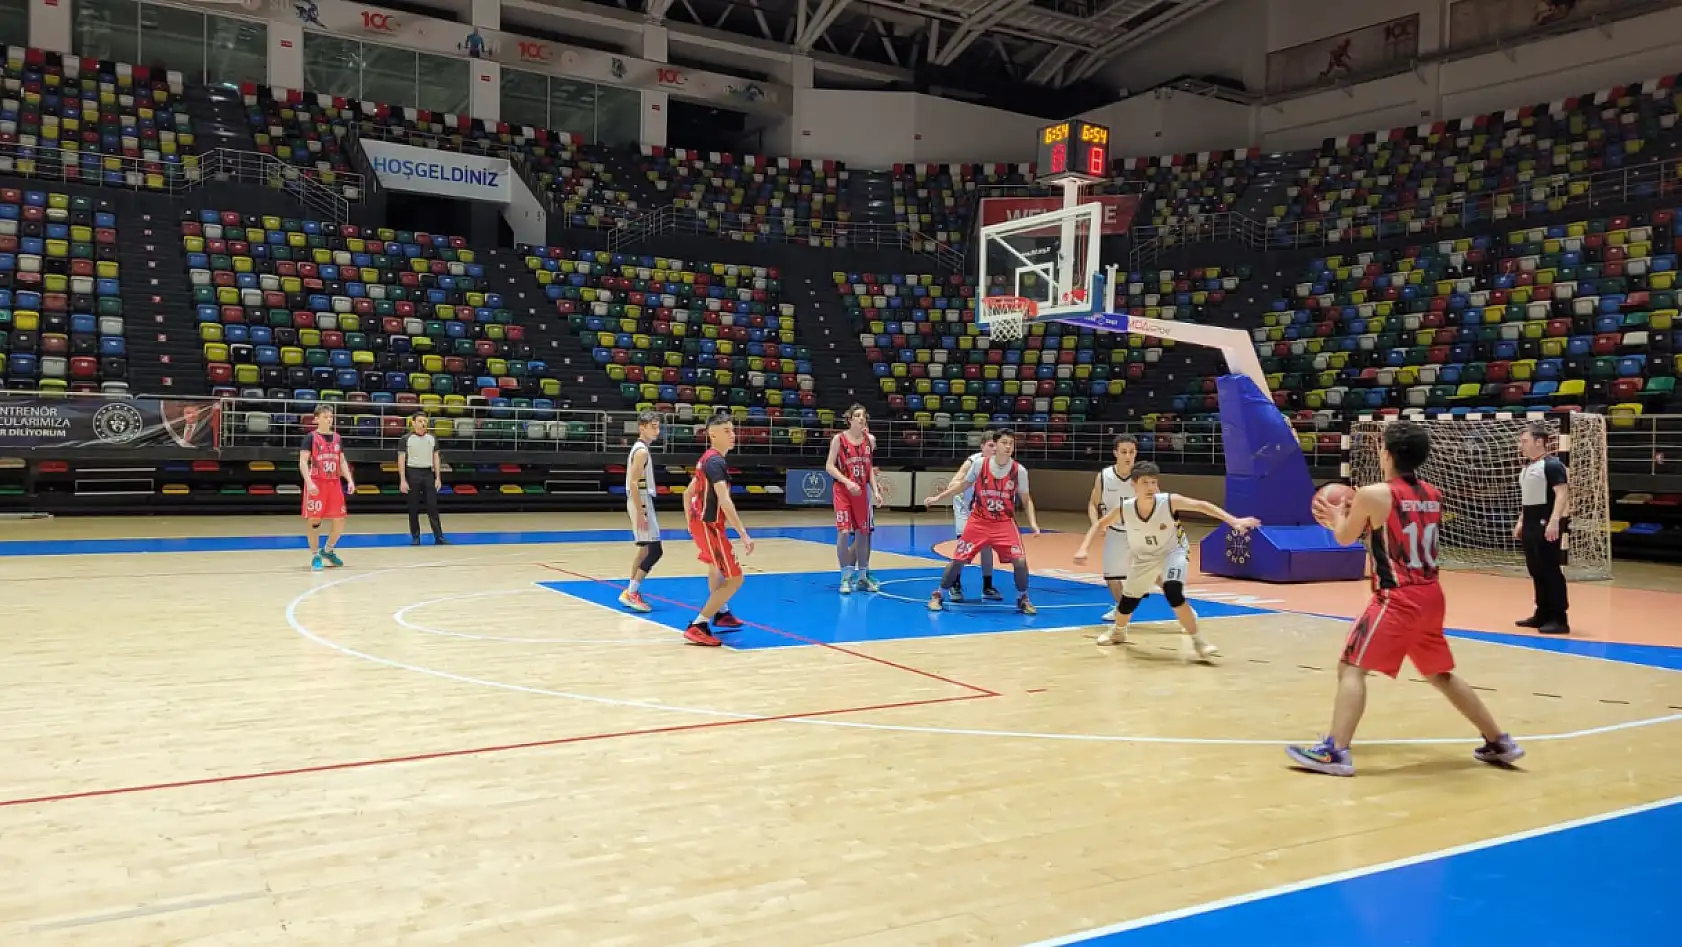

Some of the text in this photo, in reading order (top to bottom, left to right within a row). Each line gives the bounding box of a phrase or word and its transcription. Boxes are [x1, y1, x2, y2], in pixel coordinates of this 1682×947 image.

[1045, 123, 1069, 143] 6:54
[1082, 124, 1107, 144] 6:54
[373, 156, 499, 187] HOŞGELDİNİZ
[323, 460, 337, 472] 30
[853, 465, 865, 477] 61
[308, 500, 322, 512] 30
[1145, 535, 1158, 546] 61
[1402, 522, 1439, 568] 10
[1167, 568, 1181, 580] 61
